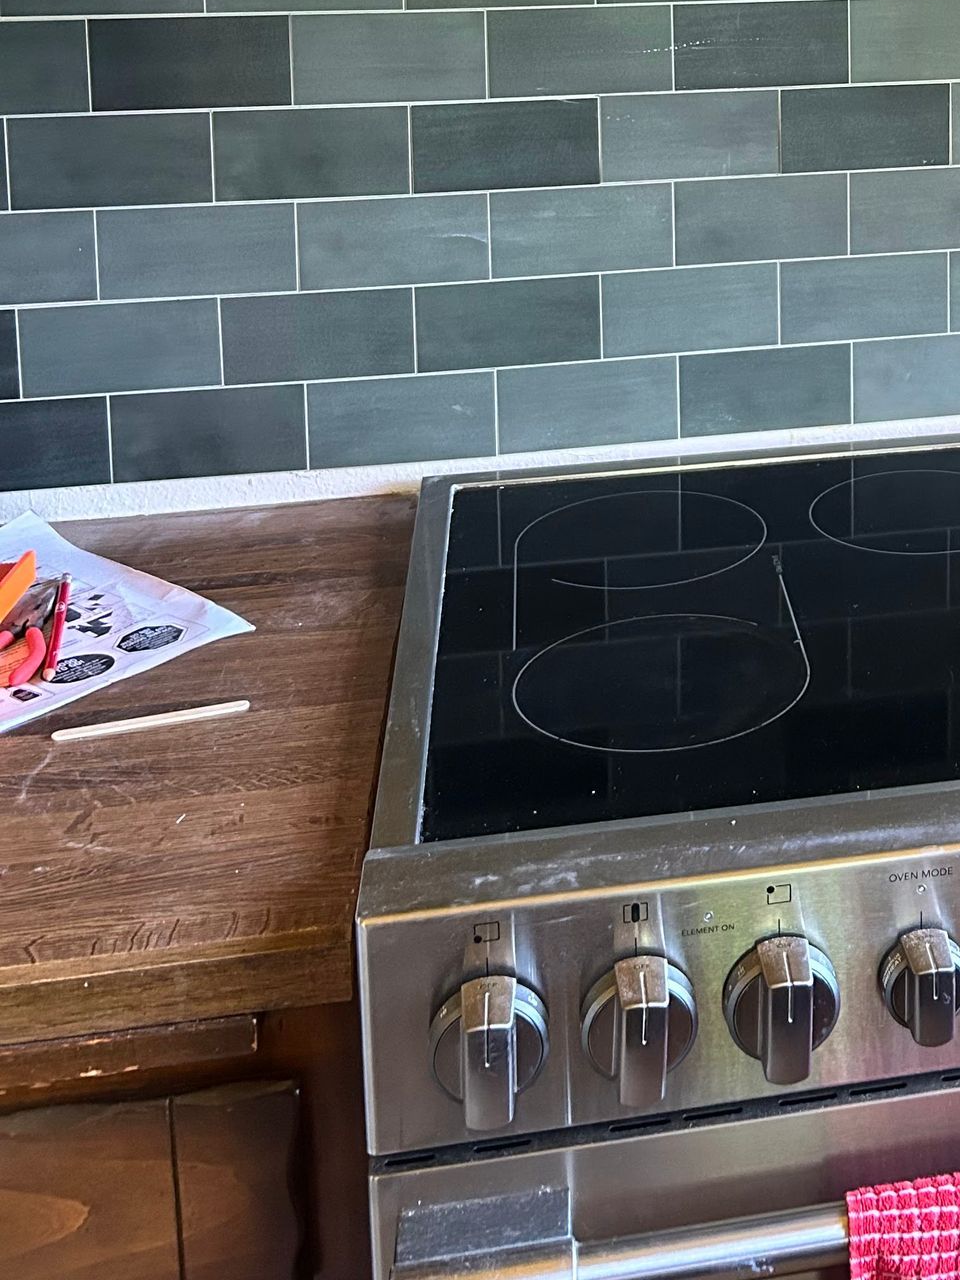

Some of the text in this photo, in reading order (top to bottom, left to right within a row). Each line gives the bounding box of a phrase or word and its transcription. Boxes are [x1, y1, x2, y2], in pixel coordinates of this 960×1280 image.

[888, 866, 953, 883] OVEN MODE
[681, 923, 735, 937] ELEMENT ON
